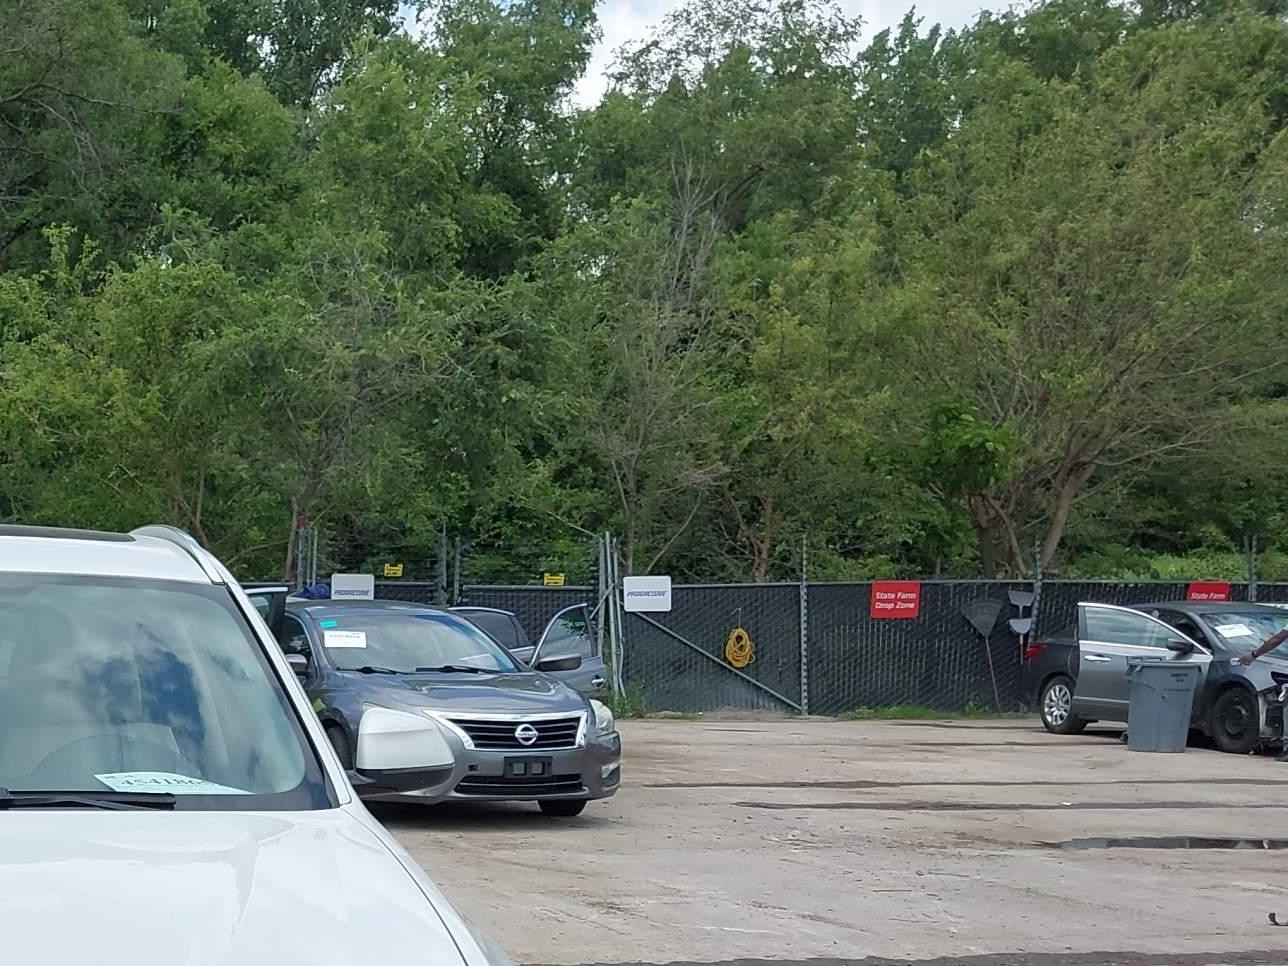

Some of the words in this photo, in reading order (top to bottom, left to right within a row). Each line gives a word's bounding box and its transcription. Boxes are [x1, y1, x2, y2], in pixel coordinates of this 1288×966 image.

[875, 591, 895, 600] State
[896, 591, 917, 600] Farm
[1190, 592, 1208, 600] State
[1208, 592, 1226, 600] Farm
[875, 602, 894, 610] Drop
